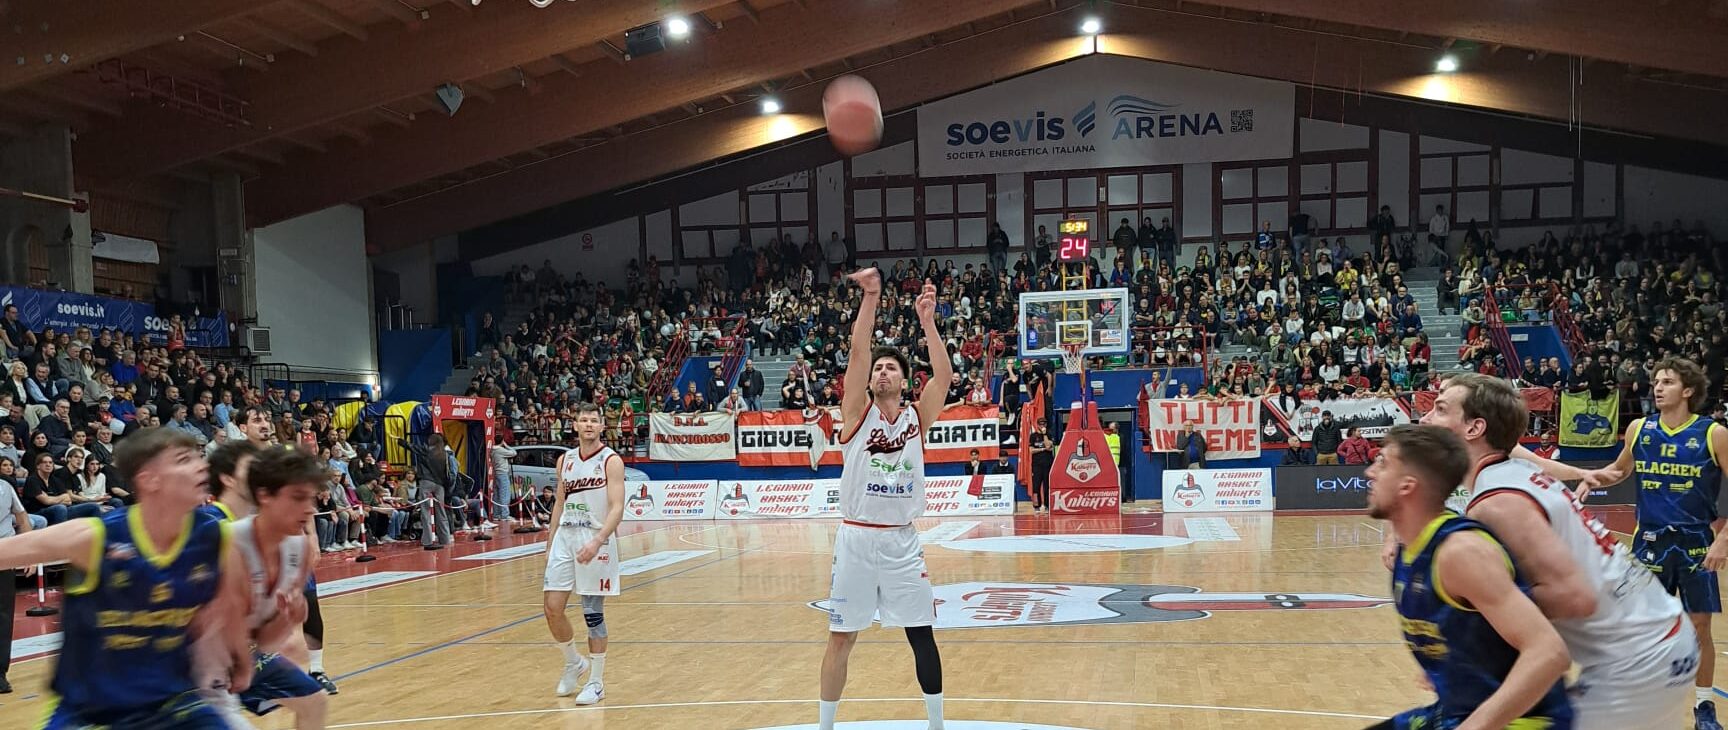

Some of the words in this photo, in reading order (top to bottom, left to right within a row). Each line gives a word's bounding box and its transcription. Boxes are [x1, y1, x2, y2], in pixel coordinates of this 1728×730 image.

[946, 111, 1065, 146] soevis
[1111, 112, 1224, 140] ARENA
[946, 150, 986, 160] SOCIETÀ
[989, 147, 1049, 158] ENERGETICA
[1052, 144, 1096, 155] ITALIANA
[1060, 238, 1087, 259] 24
[57, 302, 105, 318] soevis.it
[1160, 401, 1253, 425] TUTTI
[925, 423, 996, 444] GIATA
[1155, 429, 1257, 452] INEME
[1660, 443, 1677, 457] 12
[1213, 472, 1262, 480] LEGNANO
[1635, 460, 1702, 477] ELACHEM
[756, 483, 814, 493] LEGNANO
[866, 483, 905, 494] soevis
[926, 490, 959, 500] SKET
[759, 494, 809, 503] BASKET
[926, 501, 960, 513] GHTS
[599, 578, 611, 592] 14
